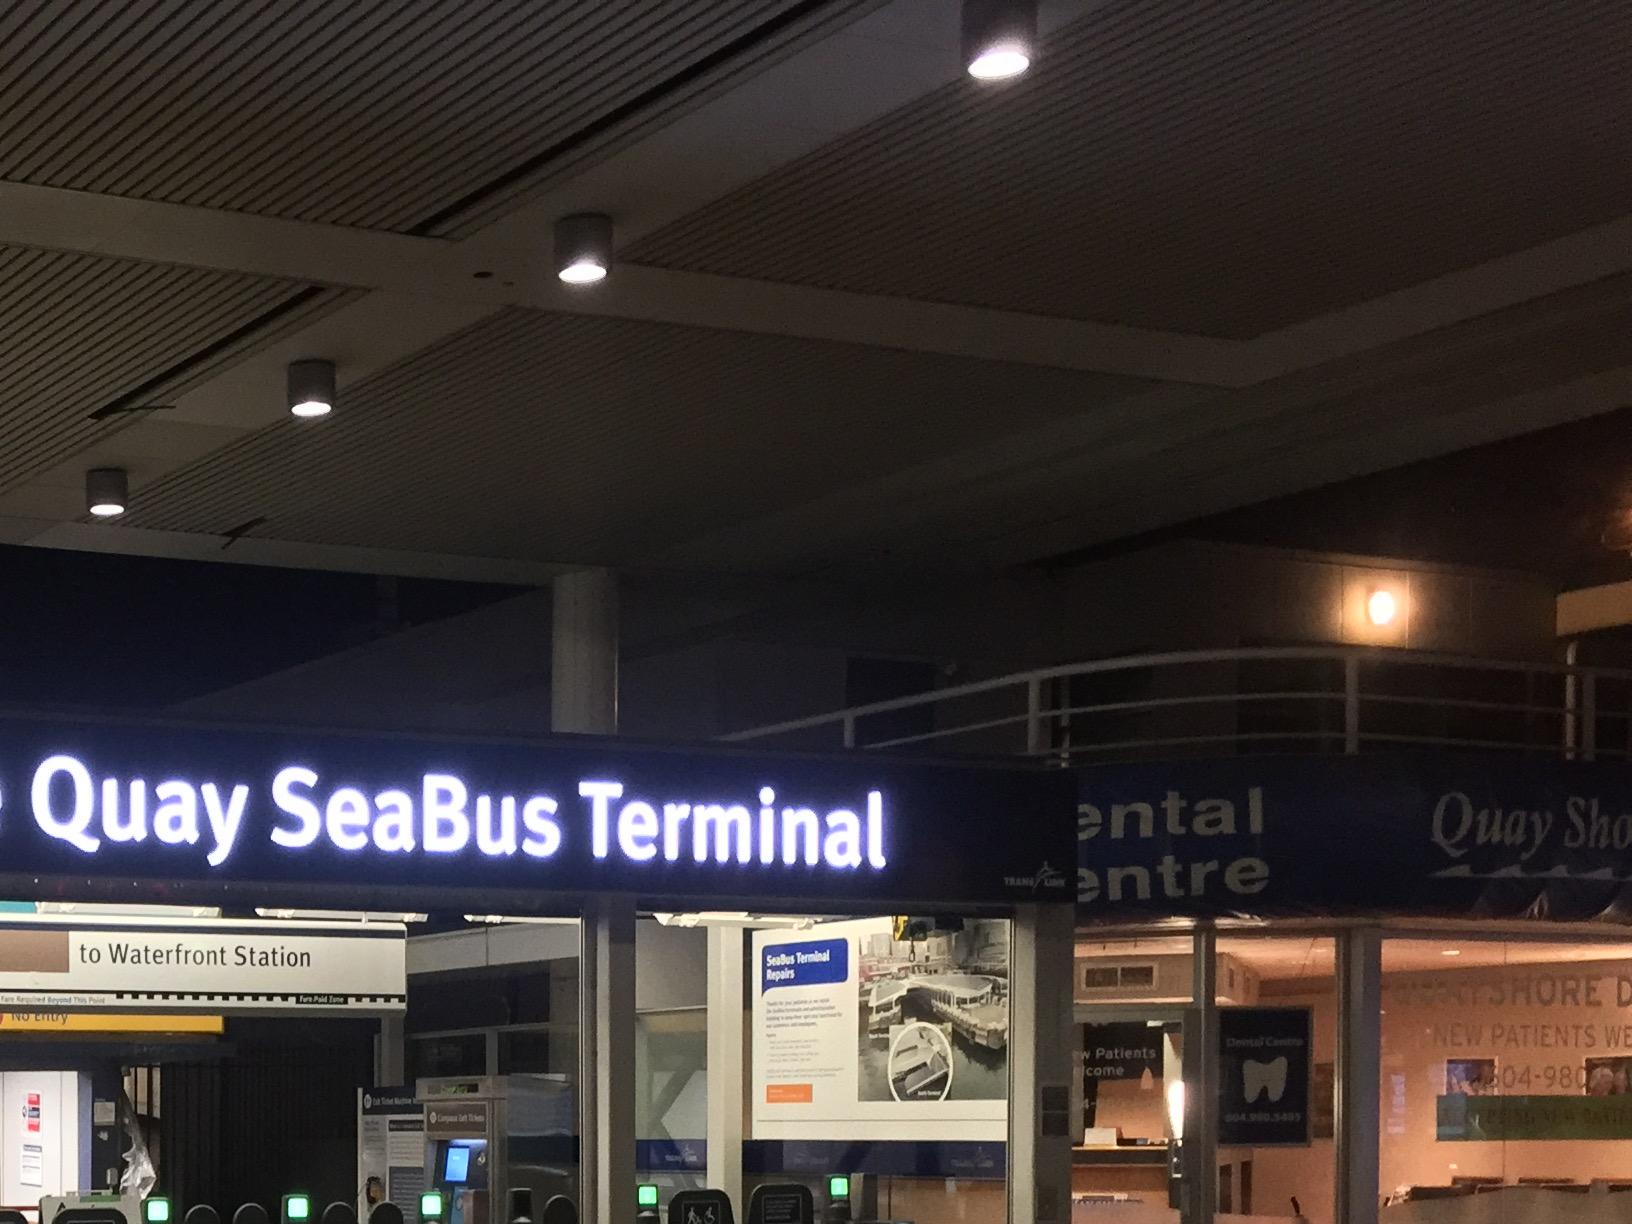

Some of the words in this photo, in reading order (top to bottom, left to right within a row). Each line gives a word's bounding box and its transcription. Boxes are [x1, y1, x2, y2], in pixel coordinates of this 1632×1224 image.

[30, 753, 249, 867] Quay
[269, 764, 562, 858] SeaBus
[578, 780, 887, 870] Terminal
[1431, 791, 1553, 861] Quay
[80, 943, 101, 964] to
[108, 942, 227, 967] Waterfront
[234, 945, 312, 968] Station
[766, 953, 795, 966] SeaBus
[796, 949, 831, 964] Terminal
[766, 968, 795, 982] Repairs
[1432, 1023, 1483, 1047] NEW
[1491, 1023, 1597, 1048] PATIENTS
[1095, 1047, 1157, 1060] Patients
